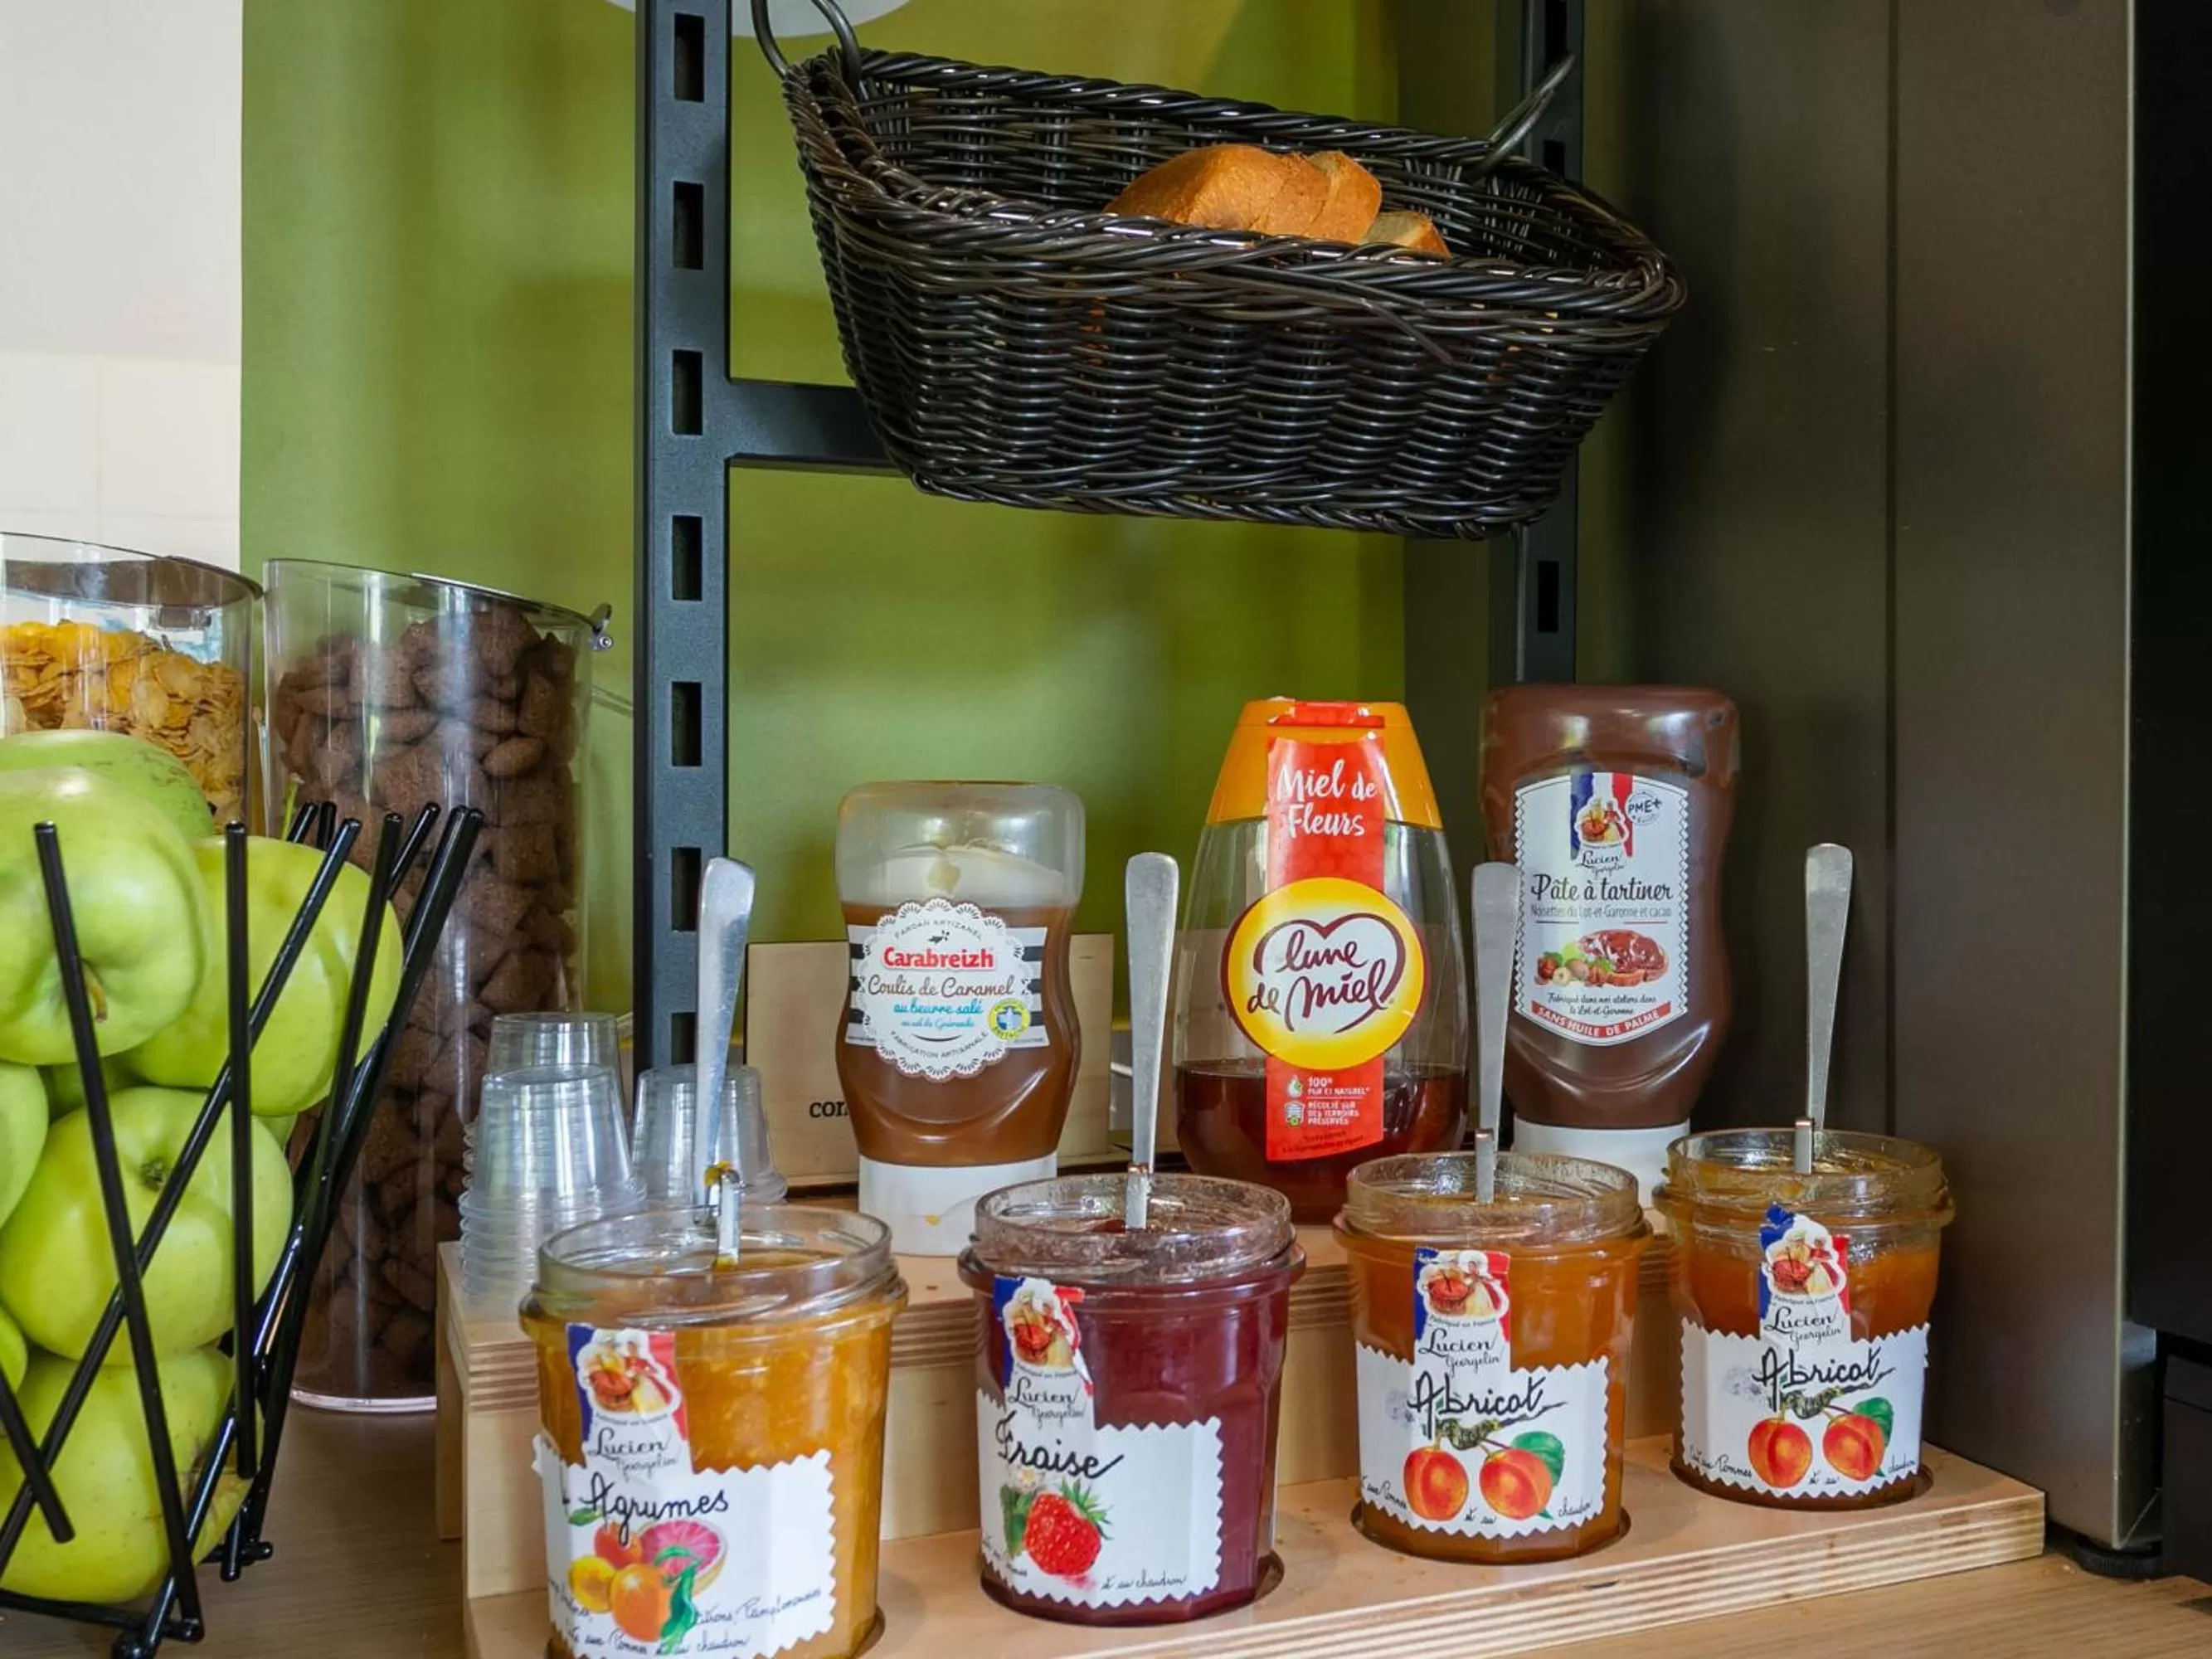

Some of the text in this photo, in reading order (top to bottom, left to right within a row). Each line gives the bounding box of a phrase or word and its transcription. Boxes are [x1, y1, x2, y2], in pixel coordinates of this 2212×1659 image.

[1277, 758, 1377, 803] Miel de
[1288, 803, 1366, 838] Fleurs
[1576, 850, 1621, 868] Lucien
[1531, 873, 1674, 901] Pâte à tartiner
[882, 946, 994, 969] Carabreizh
[1276, 929, 1369, 973] lune
[868, 974, 1014, 998] Coulis de Caramel
[1247, 982, 1281, 1015] de
[893, 1002, 908, 1014] au
[909, 997, 953, 1014] beurre
[955, 998, 984, 1014] salé
[1539, 1006, 1567, 1026] SANS
[1605, 1025, 1621, 1037] DE
[1625, 1010, 1660, 1030] PALME
[1764, 1306, 1838, 1334] Lucien
[1418, 1327, 1498, 1358] Lucien
[1008, 1376, 1080, 1409] Lucien
[1752, 1346, 1881, 1412] Abricot
[1407, 1370, 1545, 1440] Abricot
[587, 1427, 669, 1462] Lucien
[995, 1410, 1125, 1479] Fraise
[579, 1472, 730, 1547] Agrumes
